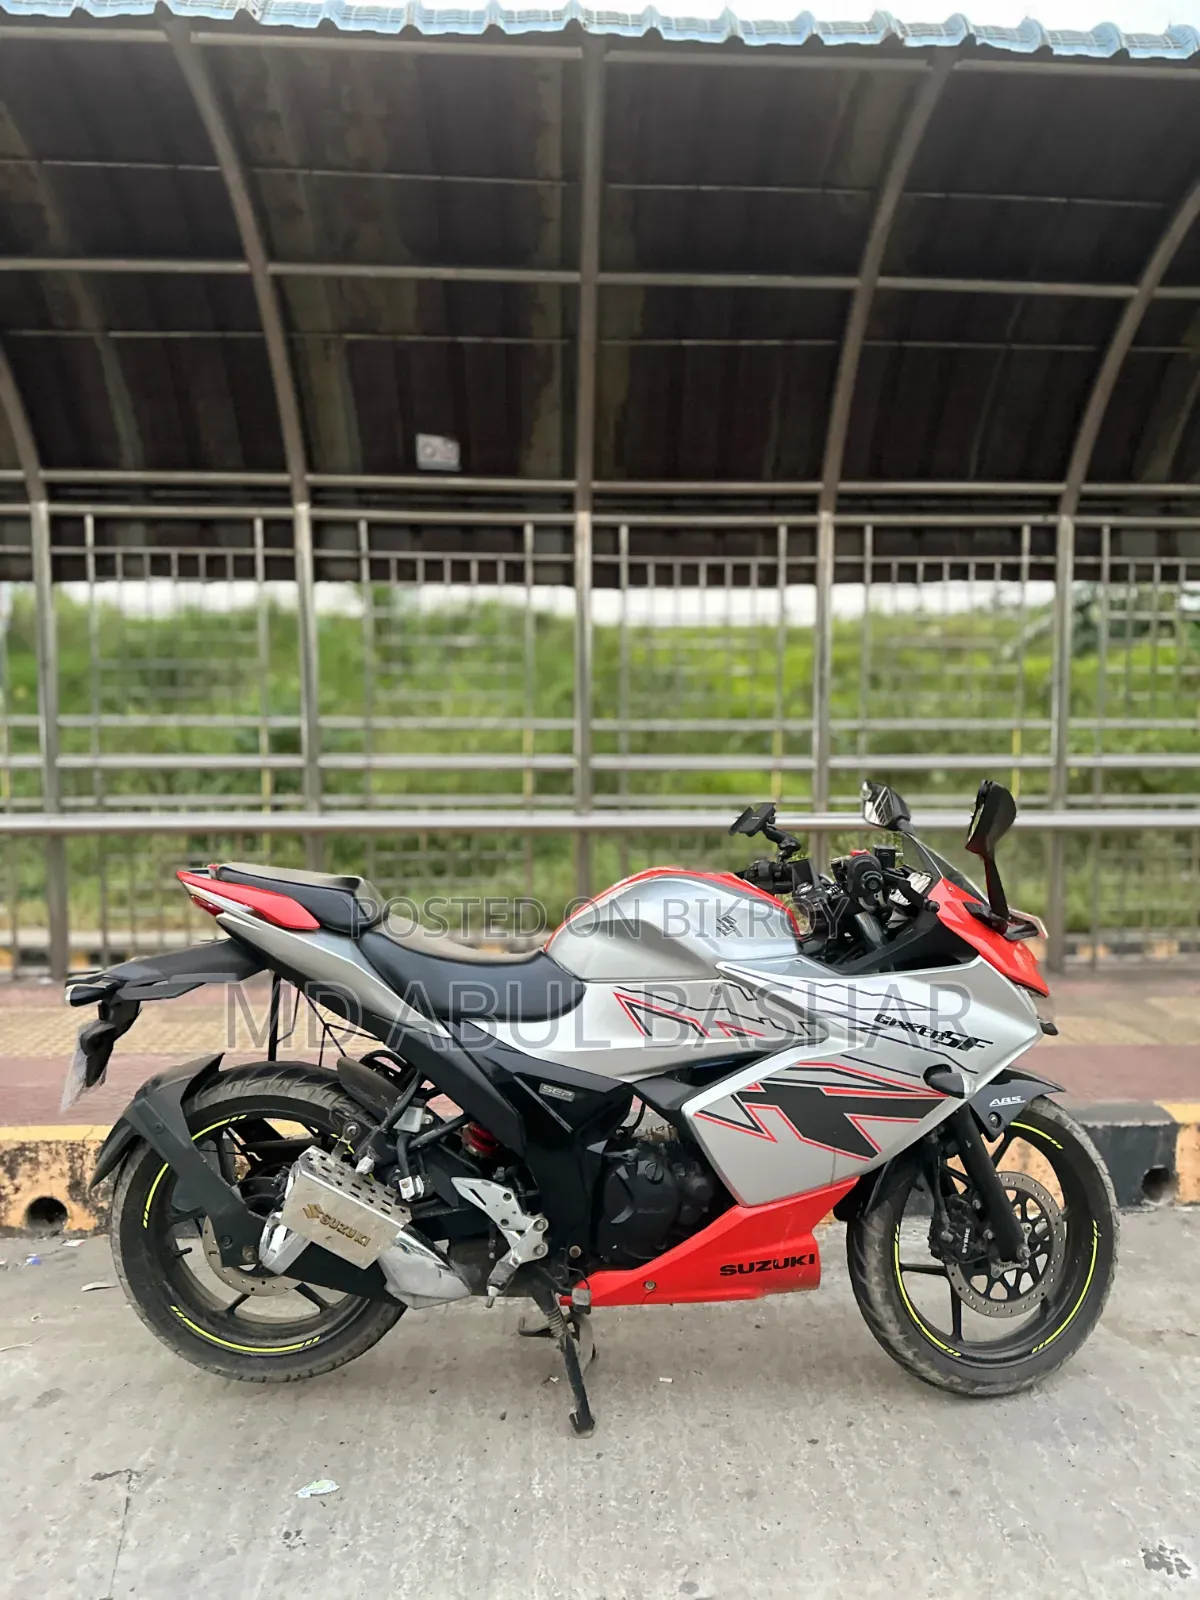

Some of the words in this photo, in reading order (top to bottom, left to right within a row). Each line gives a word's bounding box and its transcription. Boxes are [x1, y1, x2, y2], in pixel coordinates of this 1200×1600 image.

[541, 1084, 573, 1098] SEP
[989, 1095, 1025, 1107] ABS
[320, 1214, 371, 1248] SUZUKI
[719, 1253, 816, 1277] SUZUKI
